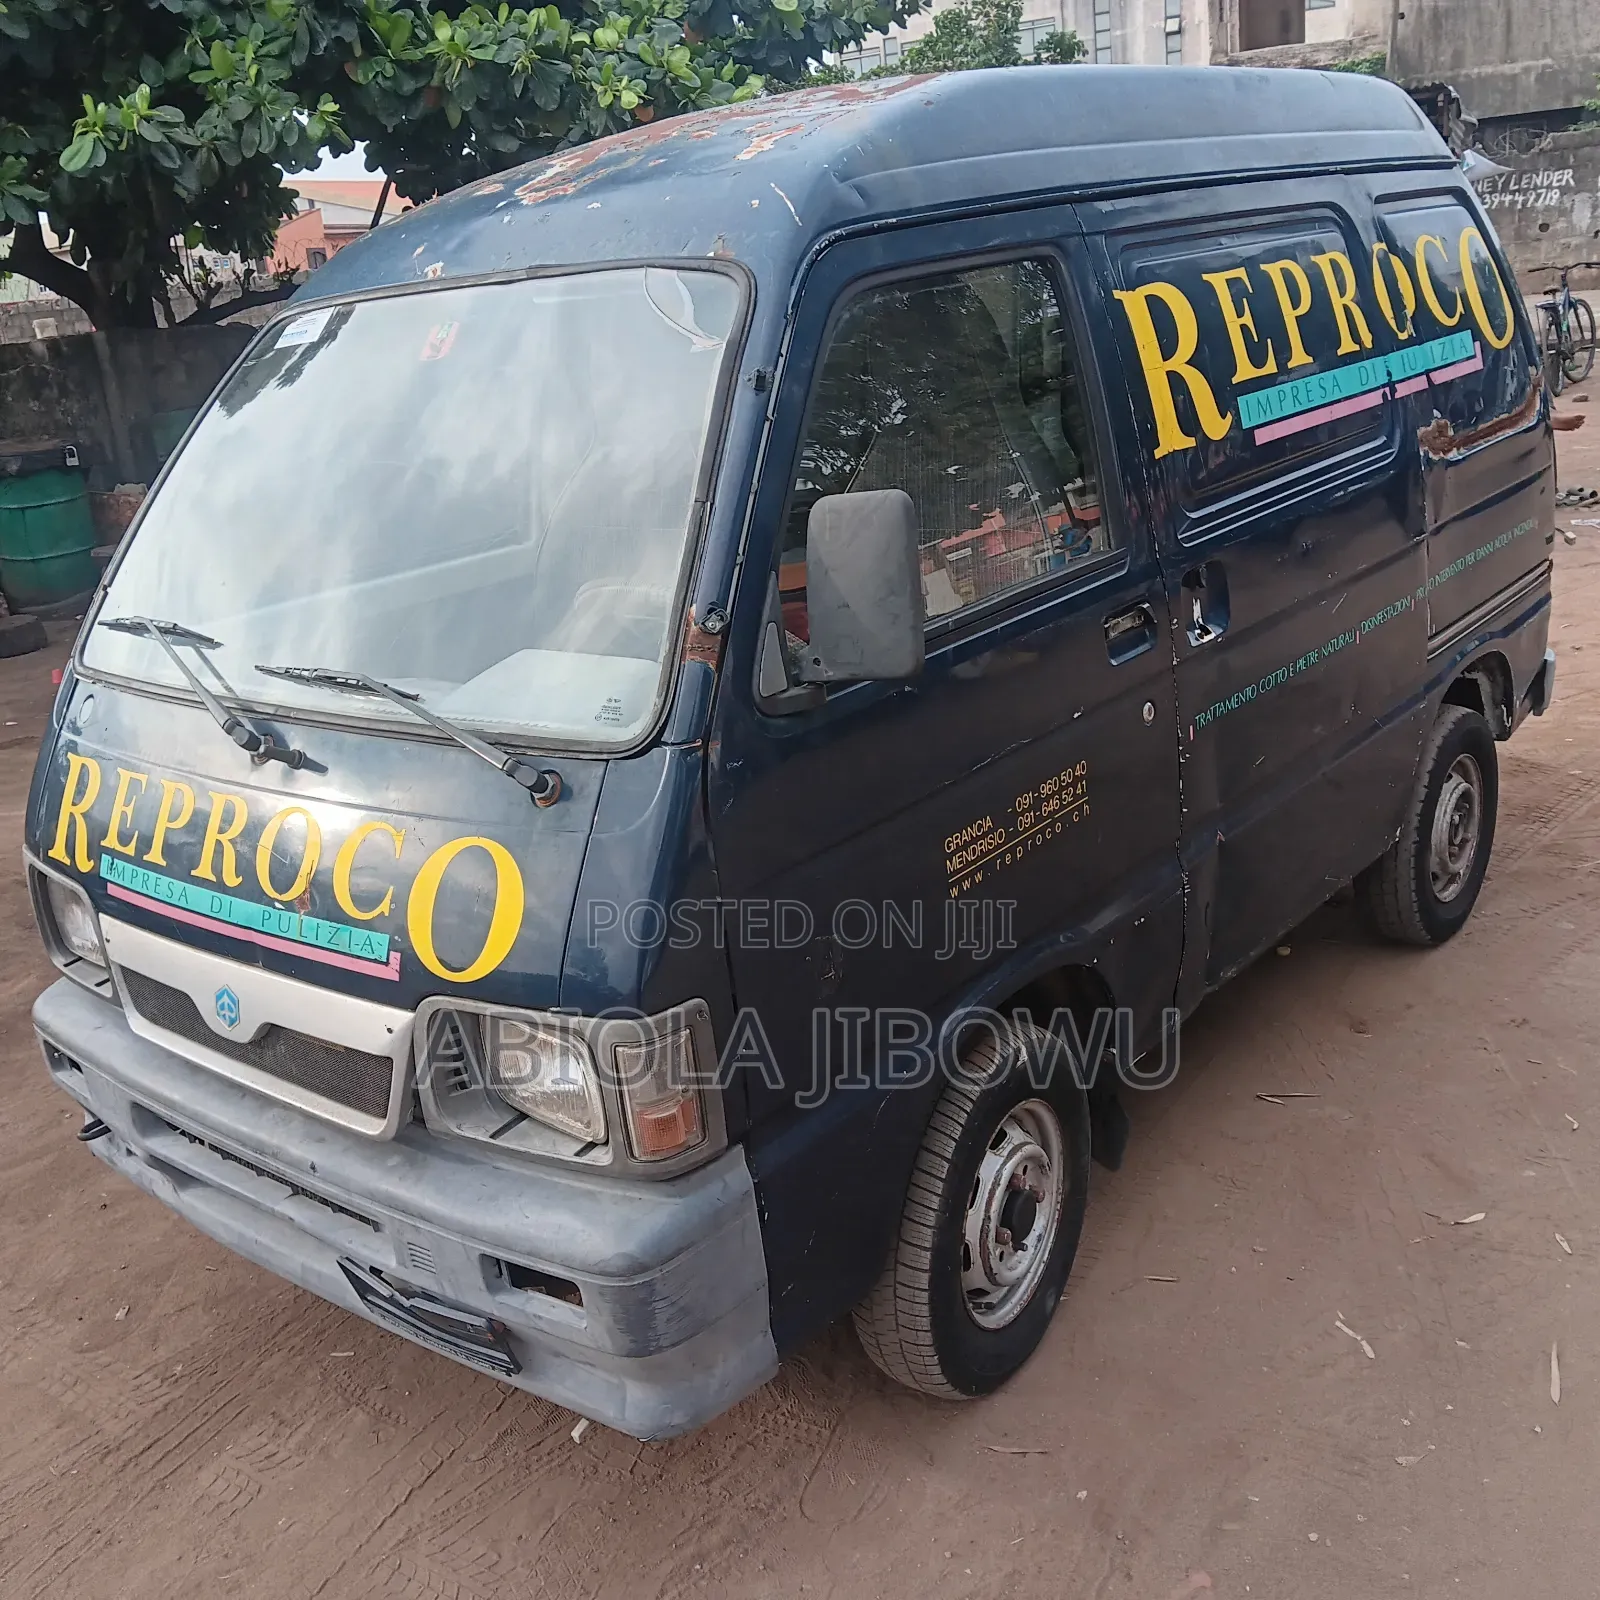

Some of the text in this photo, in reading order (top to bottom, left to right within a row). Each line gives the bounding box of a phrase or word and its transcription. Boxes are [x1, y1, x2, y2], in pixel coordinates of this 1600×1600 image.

[1509, 168, 1576, 190] LENDER
[1112, 226, 1515, 460] REPROCO
[1245, 374, 1342, 422] IMPRESA
[1358, 362, 1377, 386] DI
[1195, 684, 1257, 730] TRATTAMENTO
[1259, 666, 1288, 693] COTTO
[1289, 662, 1295, 677] E
[1296, 648, 1319, 673] PIETRE
[1321, 628, 1354, 659] NATURALI
[1361, 595, 1411, 635] DISINFESTAZIONI
[944, 815, 994, 853] GRANCIA
[1061, 768, 1073, 786] 50
[1075, 760, 1087, 777] 40
[946, 828, 1006, 875] MENDRISIO
[1062, 787, 1074, 805] 52
[1076, 779, 1087, 795] 41
[48, 751, 525, 983] REPROCO
[105, 858, 376, 956] IMPRESA DI PULIZIA
